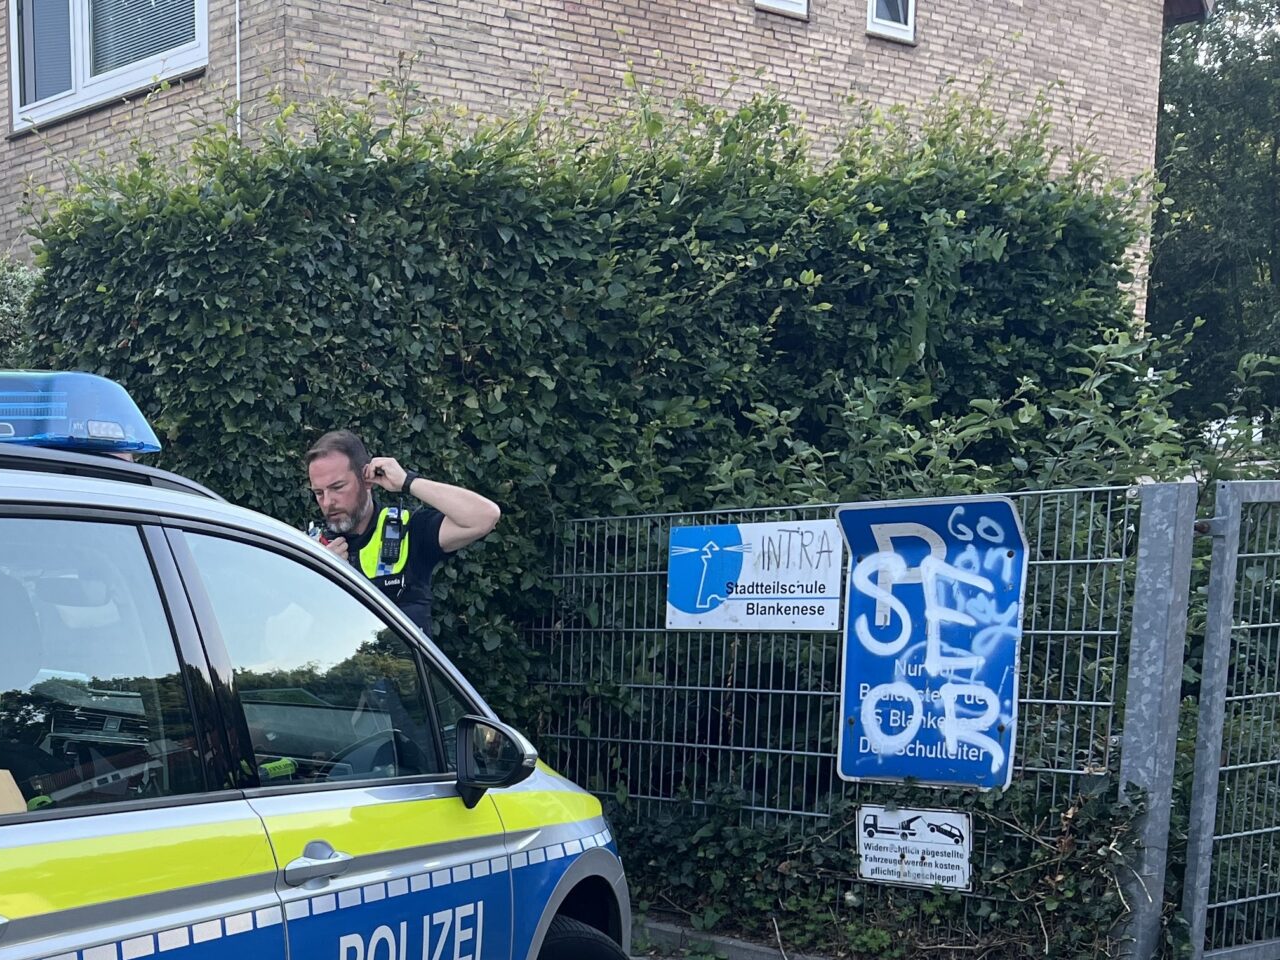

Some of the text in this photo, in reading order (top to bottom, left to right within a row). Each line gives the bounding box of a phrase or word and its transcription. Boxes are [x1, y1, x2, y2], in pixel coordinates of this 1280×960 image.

[760, 528, 833, 571] INTRA
[725, 580, 826, 595] Stadtteilschule
[746, 602, 825, 616] Blankenese
[922, 848, 964, 859] abgestellte
[864, 854, 903, 865] Fahrzeuge
[904, 858, 933, 868] werden
[870, 867, 901, 878] pflichtig
